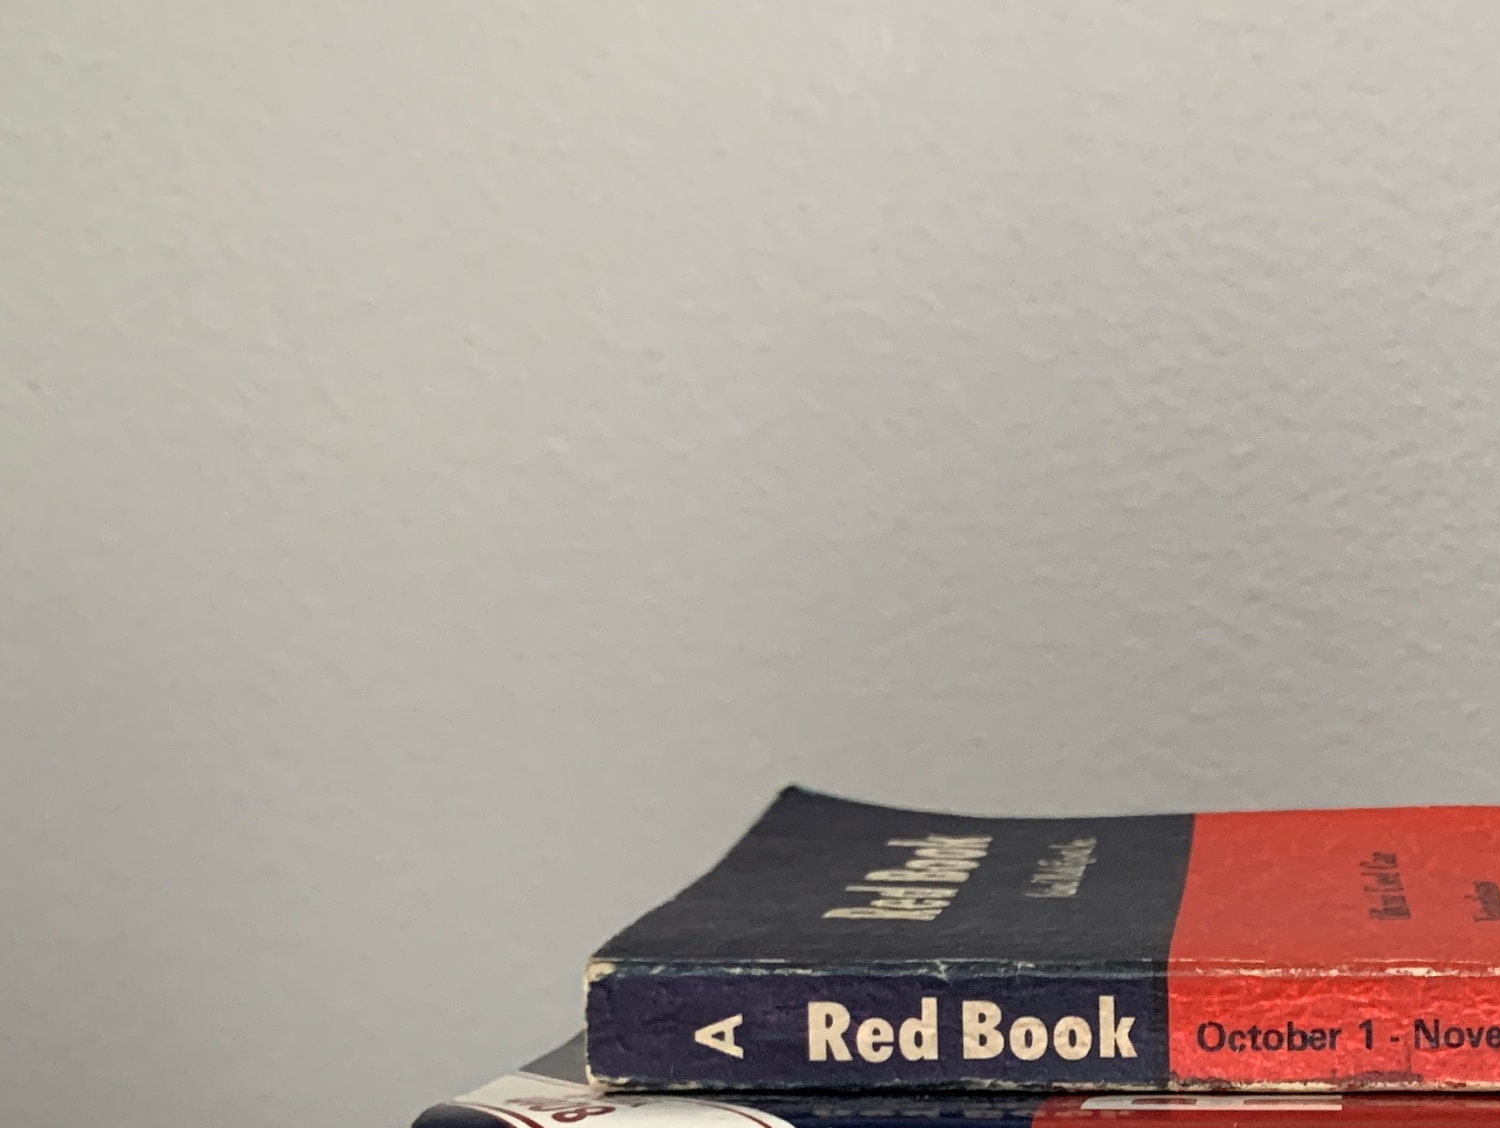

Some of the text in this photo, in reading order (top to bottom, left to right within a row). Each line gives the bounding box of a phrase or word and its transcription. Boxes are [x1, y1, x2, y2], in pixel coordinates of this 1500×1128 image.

[820, 833, 993, 922] Red Book
[693, 994, 1139, 1063] A Red Book
[1196, 1020, 1342, 1053] October
[1358, 1018, 1374, 1051] 1
